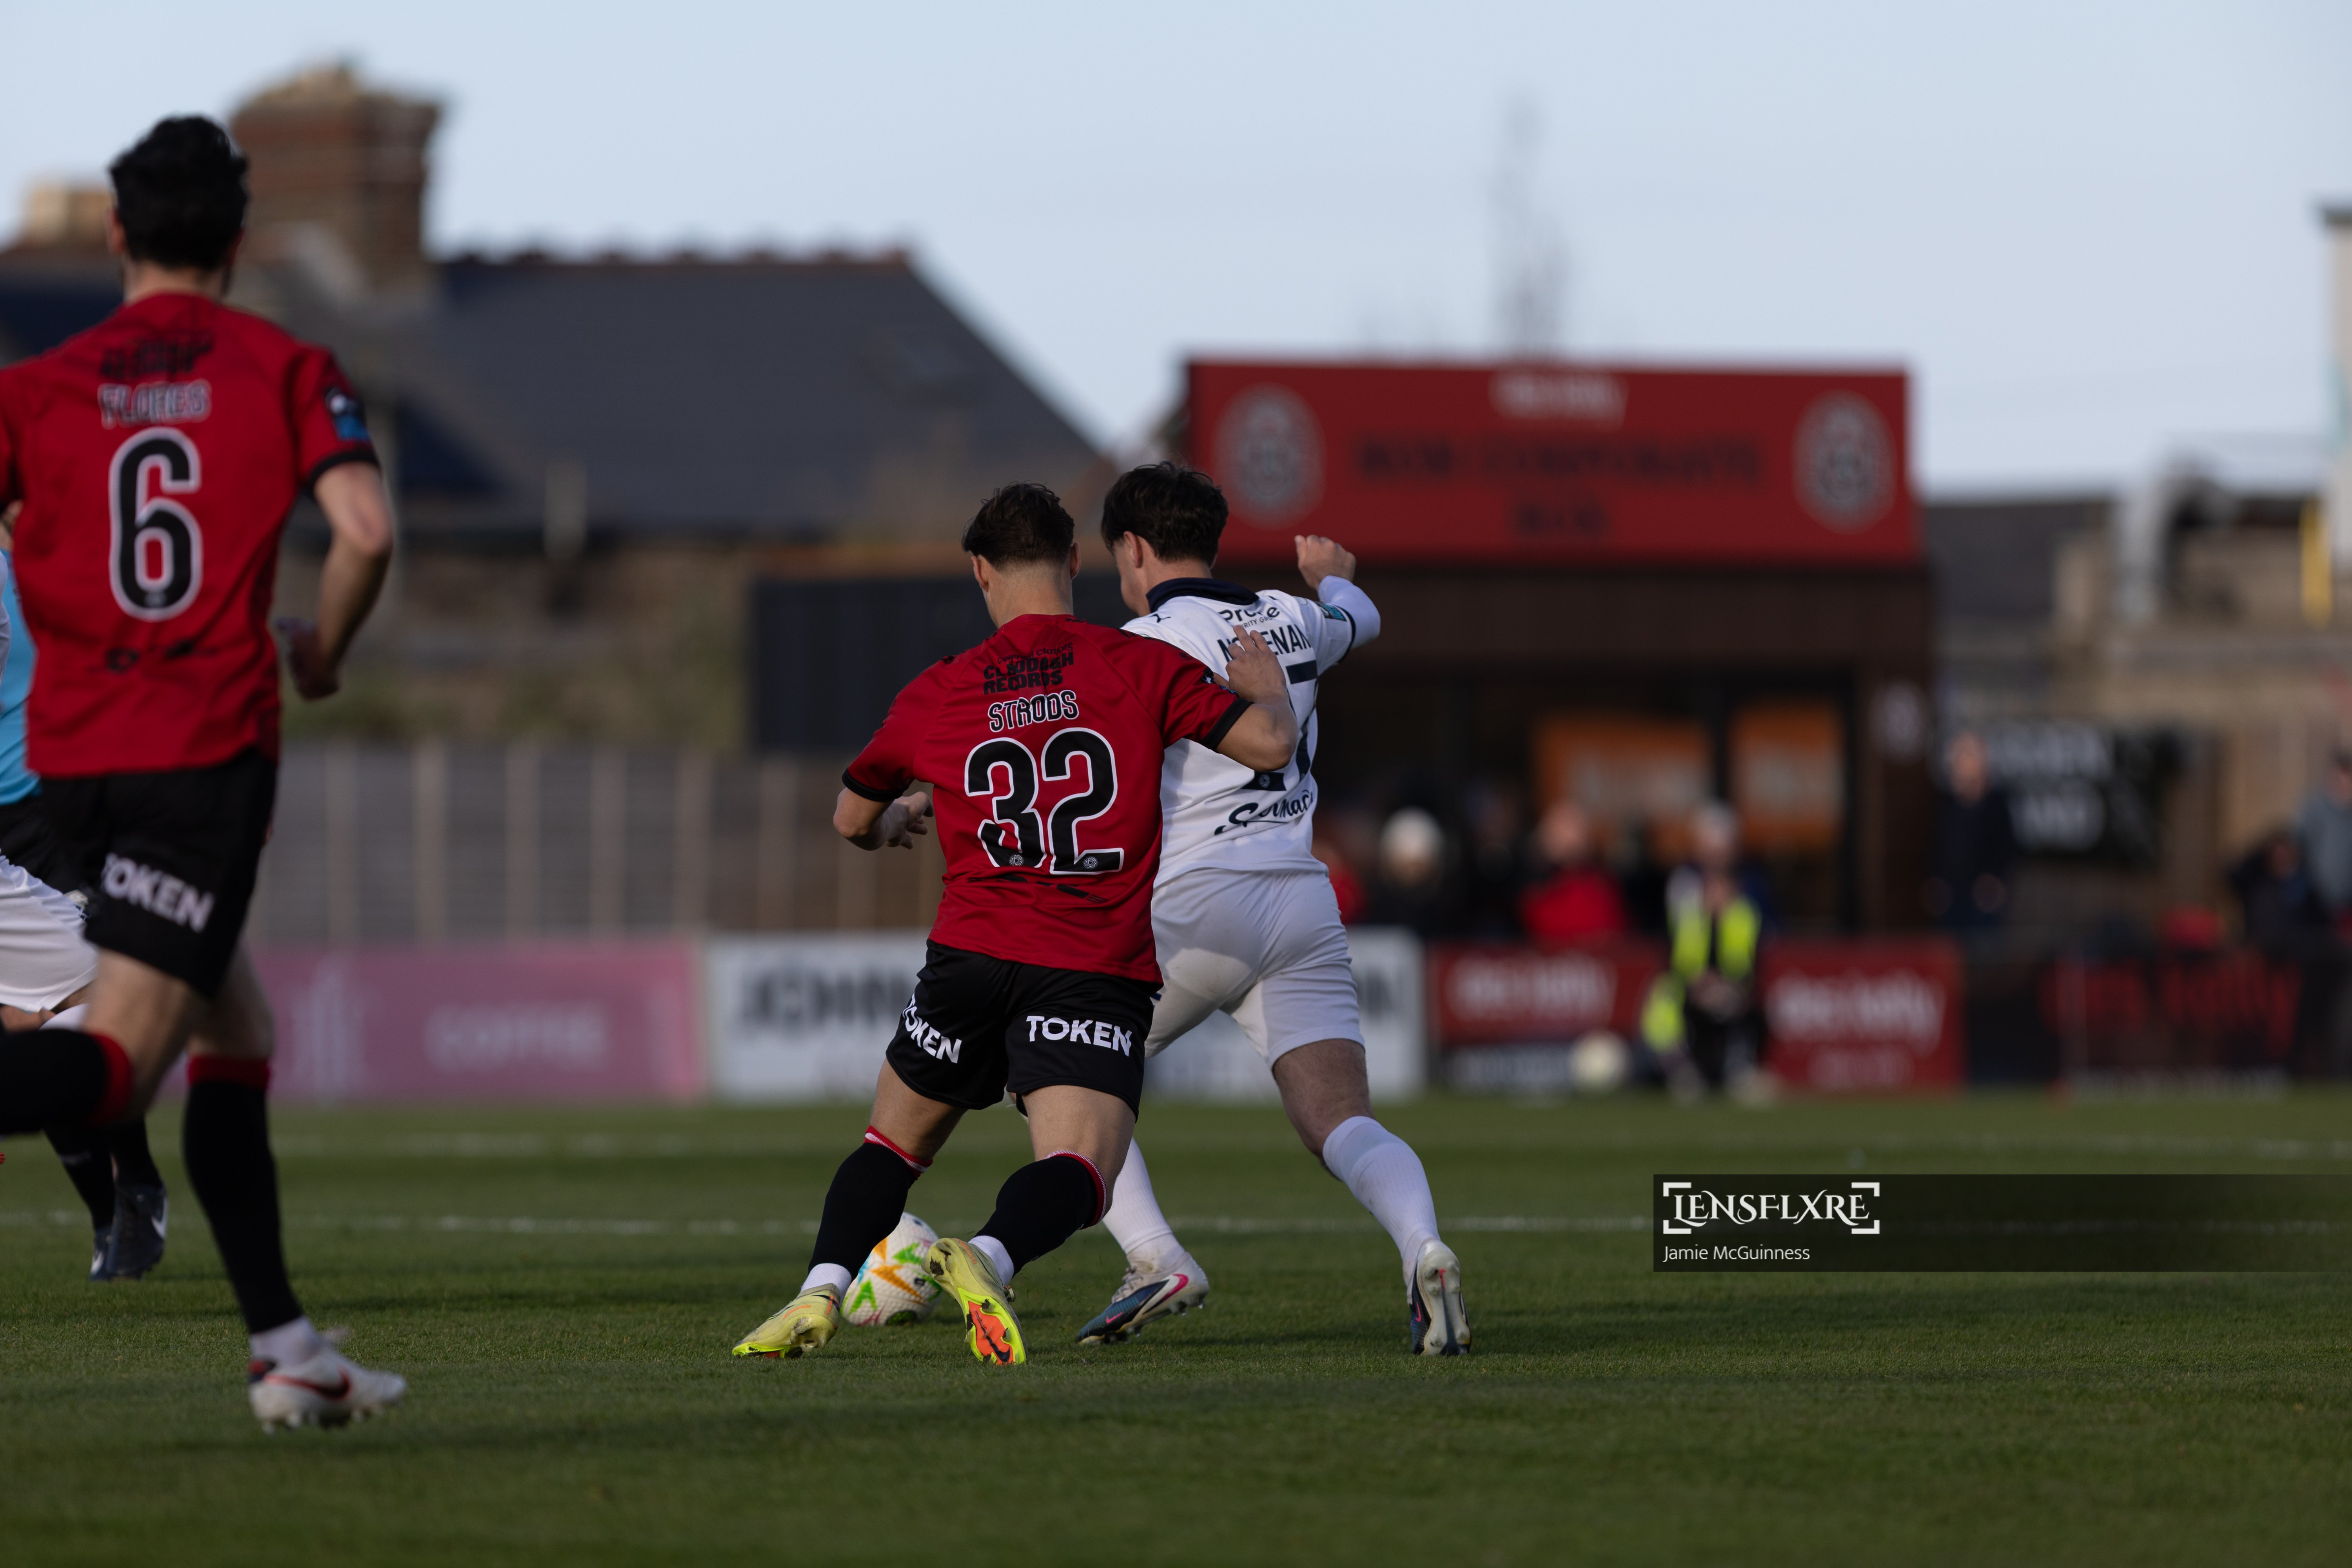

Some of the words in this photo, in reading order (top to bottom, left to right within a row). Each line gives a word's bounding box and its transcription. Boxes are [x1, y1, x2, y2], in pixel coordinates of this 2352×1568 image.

[109, 426, 203, 622] 6
[984, 670, 1063, 695] RECORDS
[987, 690, 1079, 732] STRODS
[964, 727, 1124, 875] 32
[1026, 1016, 1132, 1057] TOKEN
